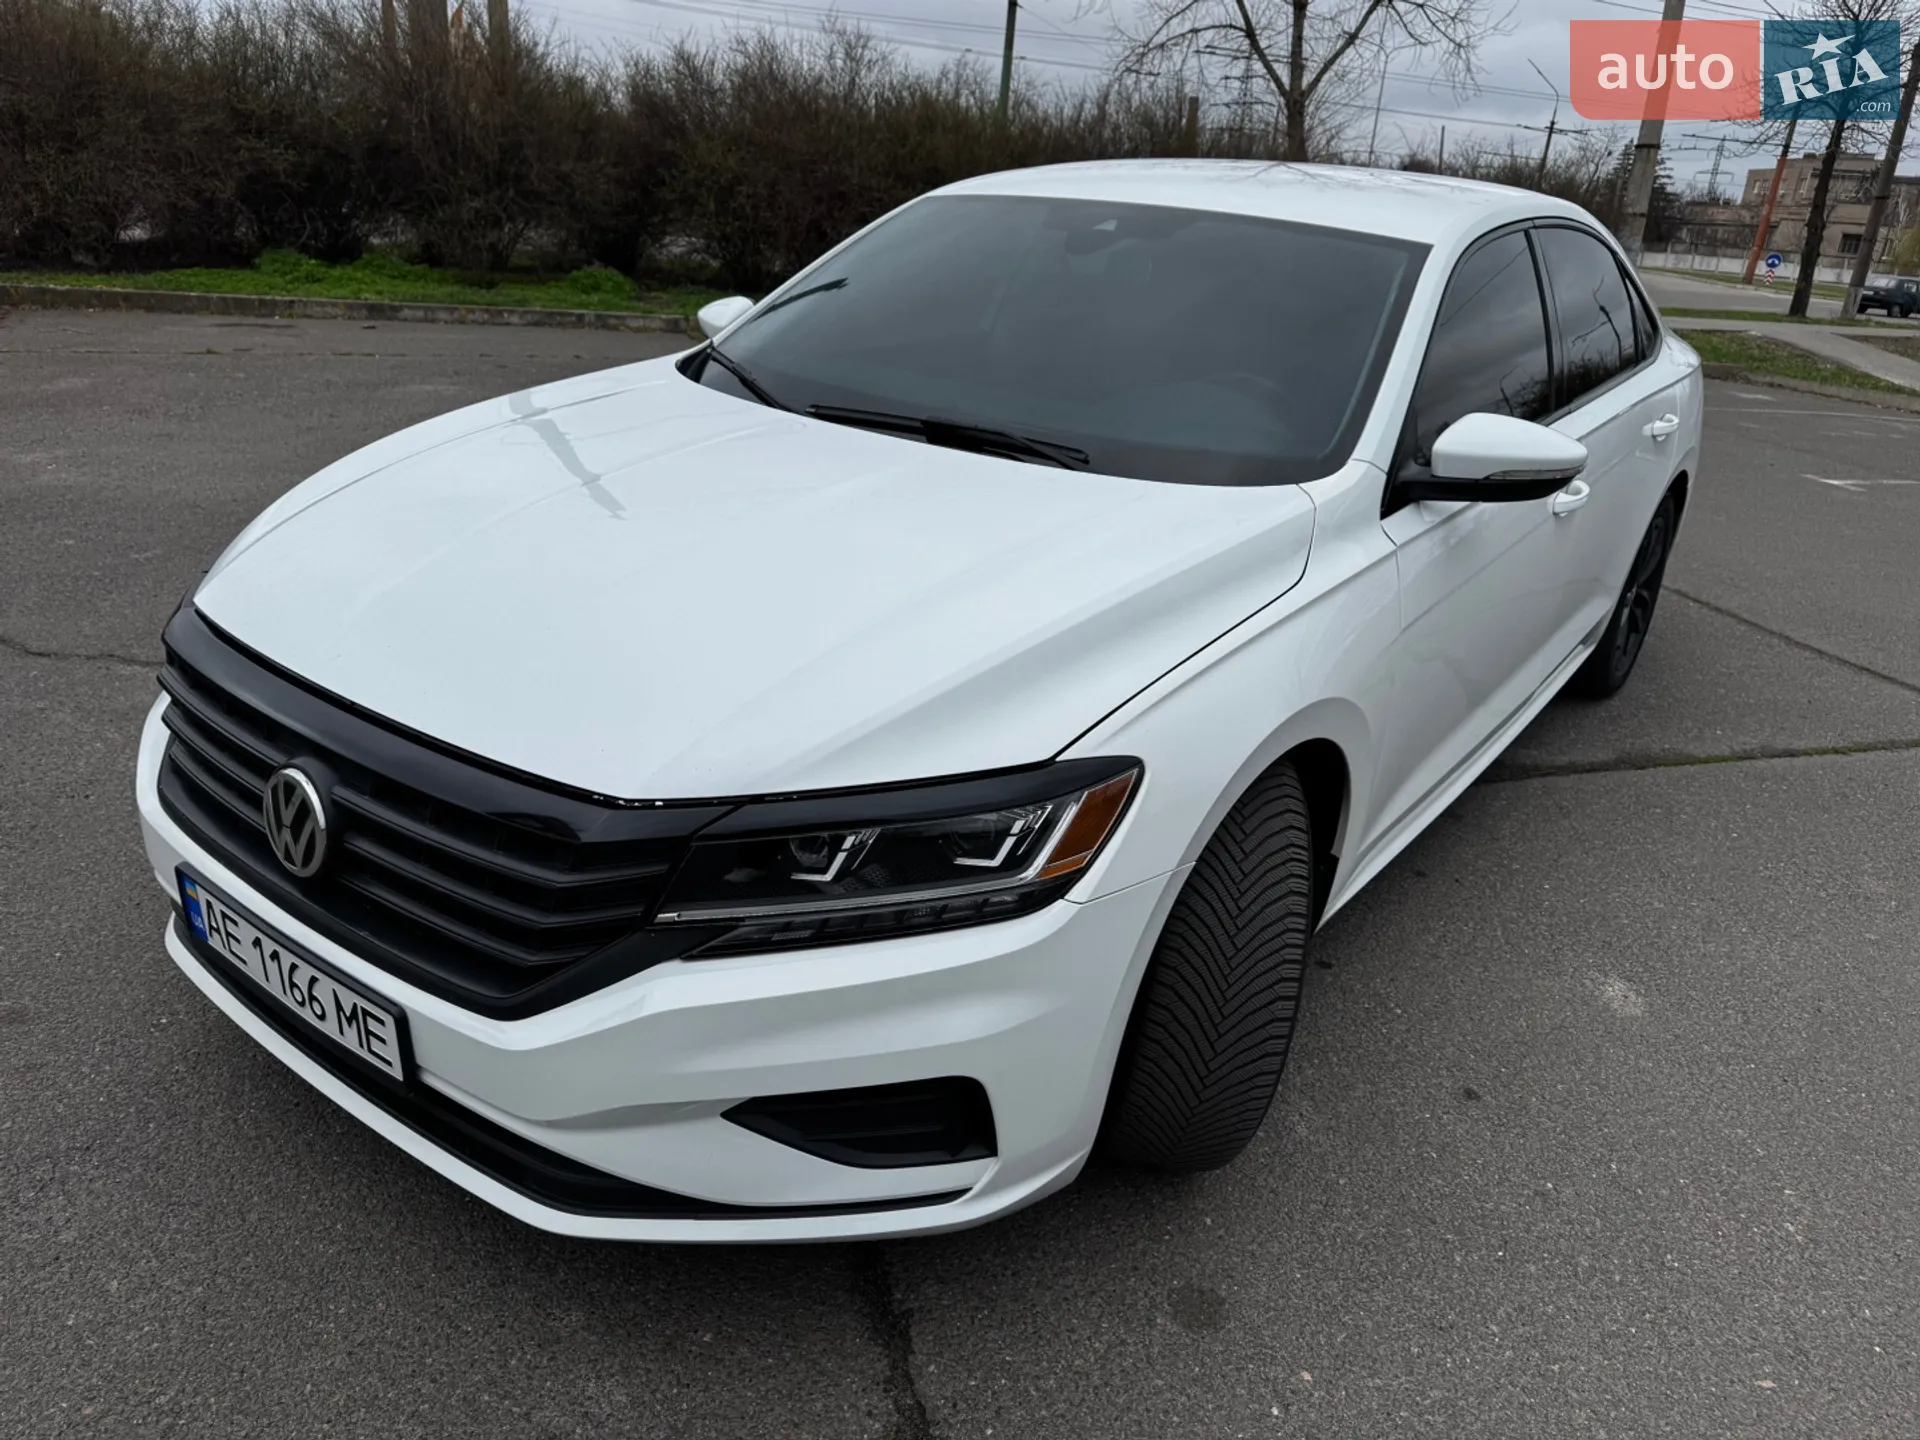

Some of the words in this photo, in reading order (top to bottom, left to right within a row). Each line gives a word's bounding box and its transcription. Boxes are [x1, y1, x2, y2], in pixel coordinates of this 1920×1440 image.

[206, 899, 247, 966] AE
[252, 936, 326, 1021] 1166
[332, 988, 393, 1068] ME
